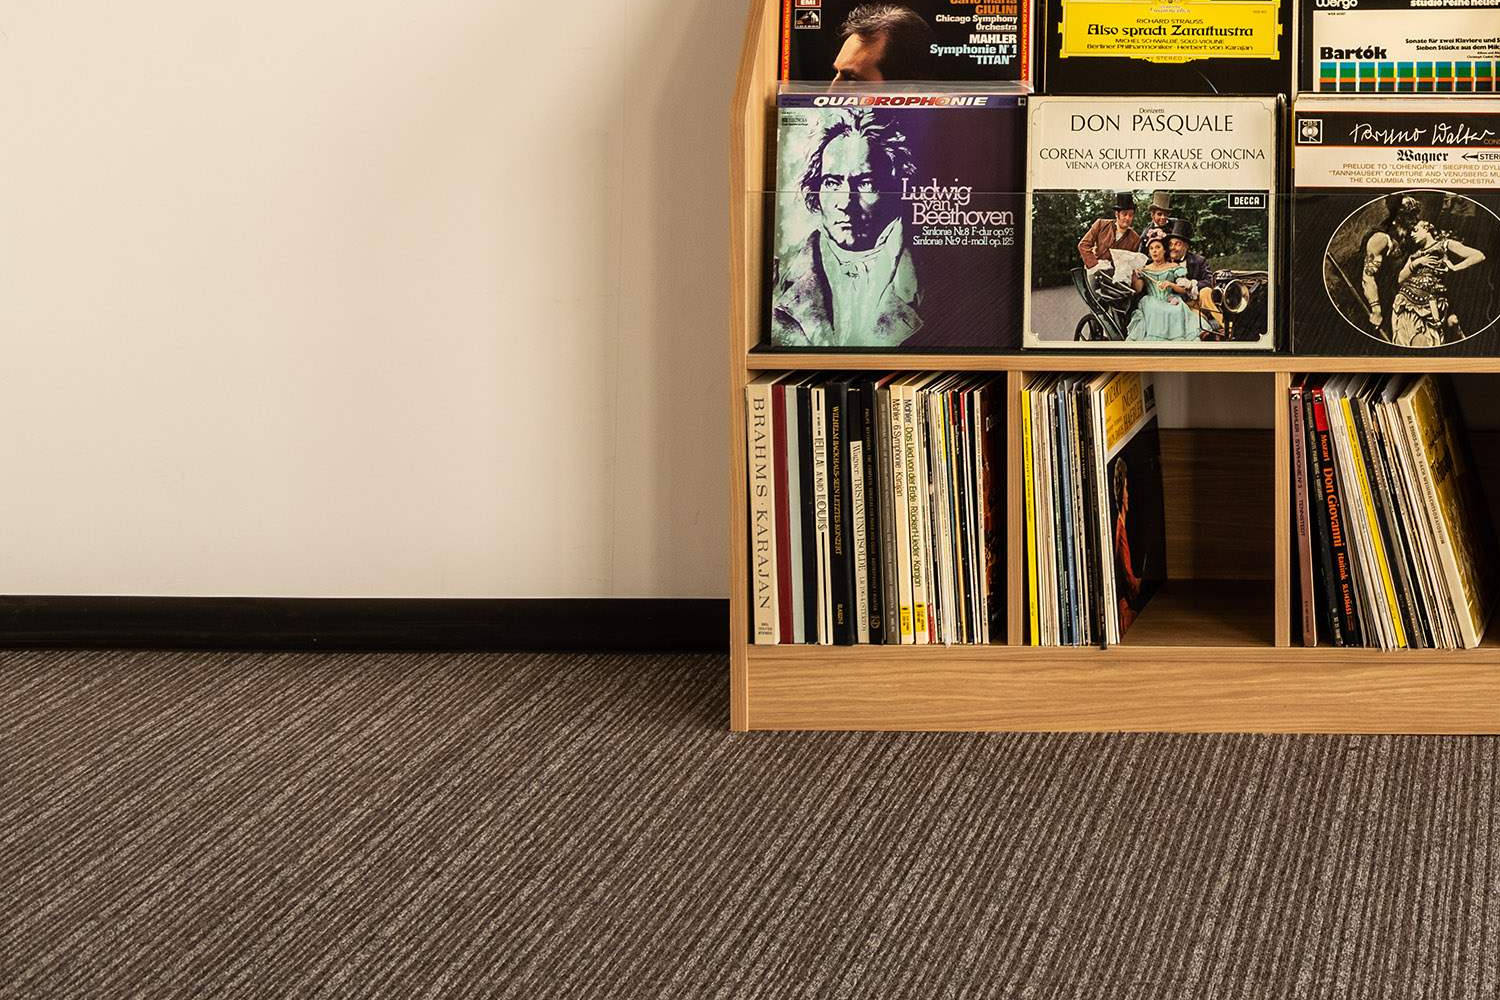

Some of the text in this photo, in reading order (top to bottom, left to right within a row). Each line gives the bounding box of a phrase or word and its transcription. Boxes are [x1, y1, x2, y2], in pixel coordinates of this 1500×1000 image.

[976, 5, 1017, 14] GIULINI
[1316, 0, 1358, 9] wergo
[936, 15, 1017, 24] Chicago Symphony
[1088, 24, 1253, 37] Also sprach Zarathustra
[970, 34, 1017, 43] MAHLER
[1320, 45, 1387, 60] Bartók
[814, 97, 988, 108] QUADROPHONIE
[1071, 115, 1233, 135] DON PASQUALE
[1040, 149, 1265, 160] CORENA SCIUTTI KRAUSE ONCINA
[1397, 150, 1448, 163] Wagner
[1127, 171, 1176, 182] KERTESZ
[902, 178, 972, 205] Ludwig
[923, 200, 950, 210] van
[1235, 197, 1260, 205] DECCA
[912, 203, 1014, 225] Beethoven
[1320, 434, 1345, 547] Mozart Don Giovanni
[753, 398, 770, 609] BRAHMS KARAJAN
